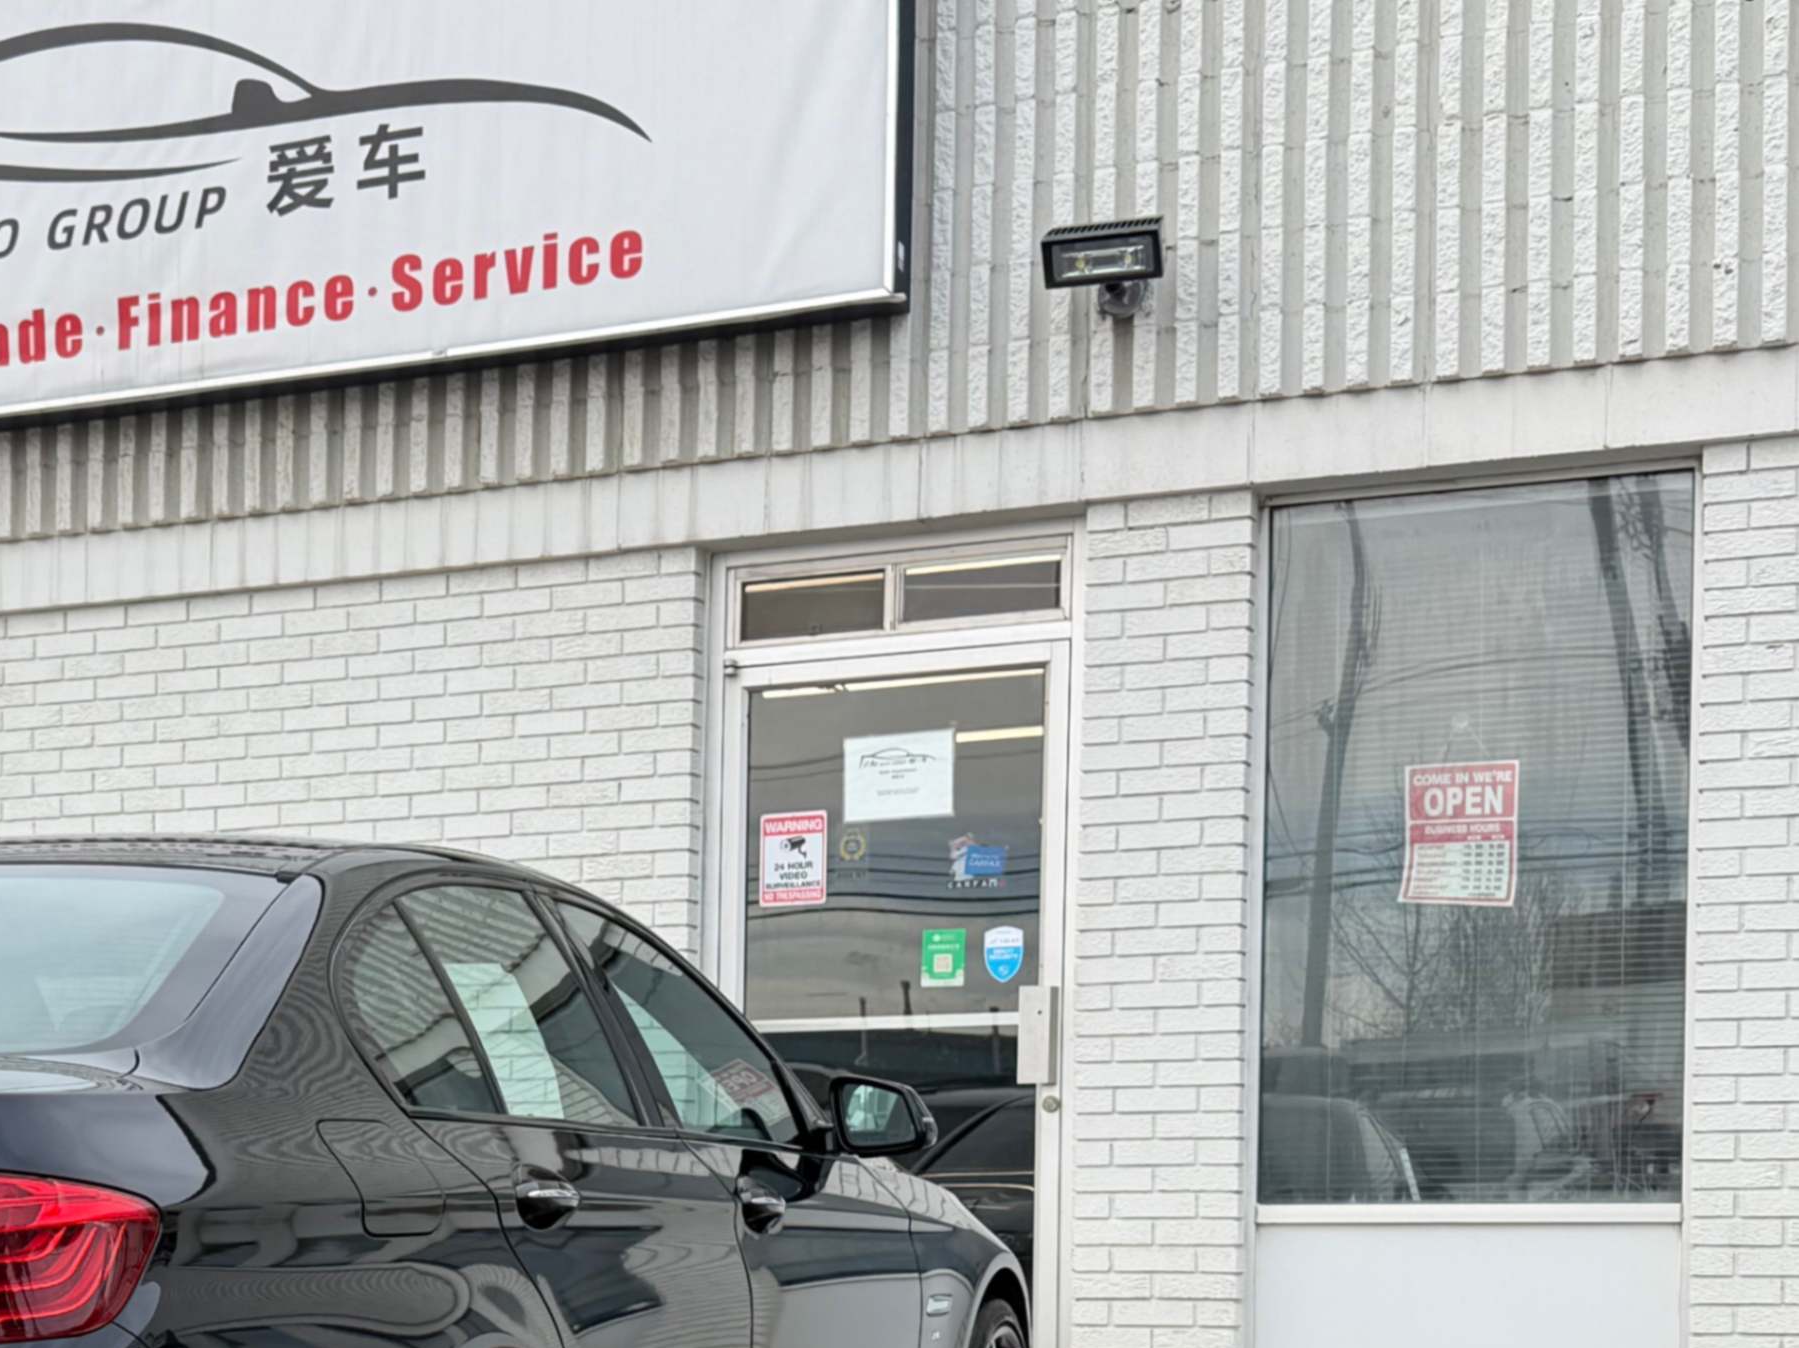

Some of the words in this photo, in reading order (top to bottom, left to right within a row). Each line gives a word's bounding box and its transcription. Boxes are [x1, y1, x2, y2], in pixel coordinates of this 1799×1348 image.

[266, 123, 426, 217] 爱车
[47, 186, 227, 251] GROUP
[117, 275, 355, 350] Finance
[391, 230, 643, 312] Service
[1413, 774, 1451, 786] COME
[1456, 772, 1469, 784] IN
[1473, 769, 1513, 782] WE'RE
[1424, 785, 1503, 817] OPEN
[764, 819, 821, 834] WARNING
[774, 863, 785, 871] 24
[788, 861, 813, 870] HOUR
[779, 871, 808, 880] VIDEO
